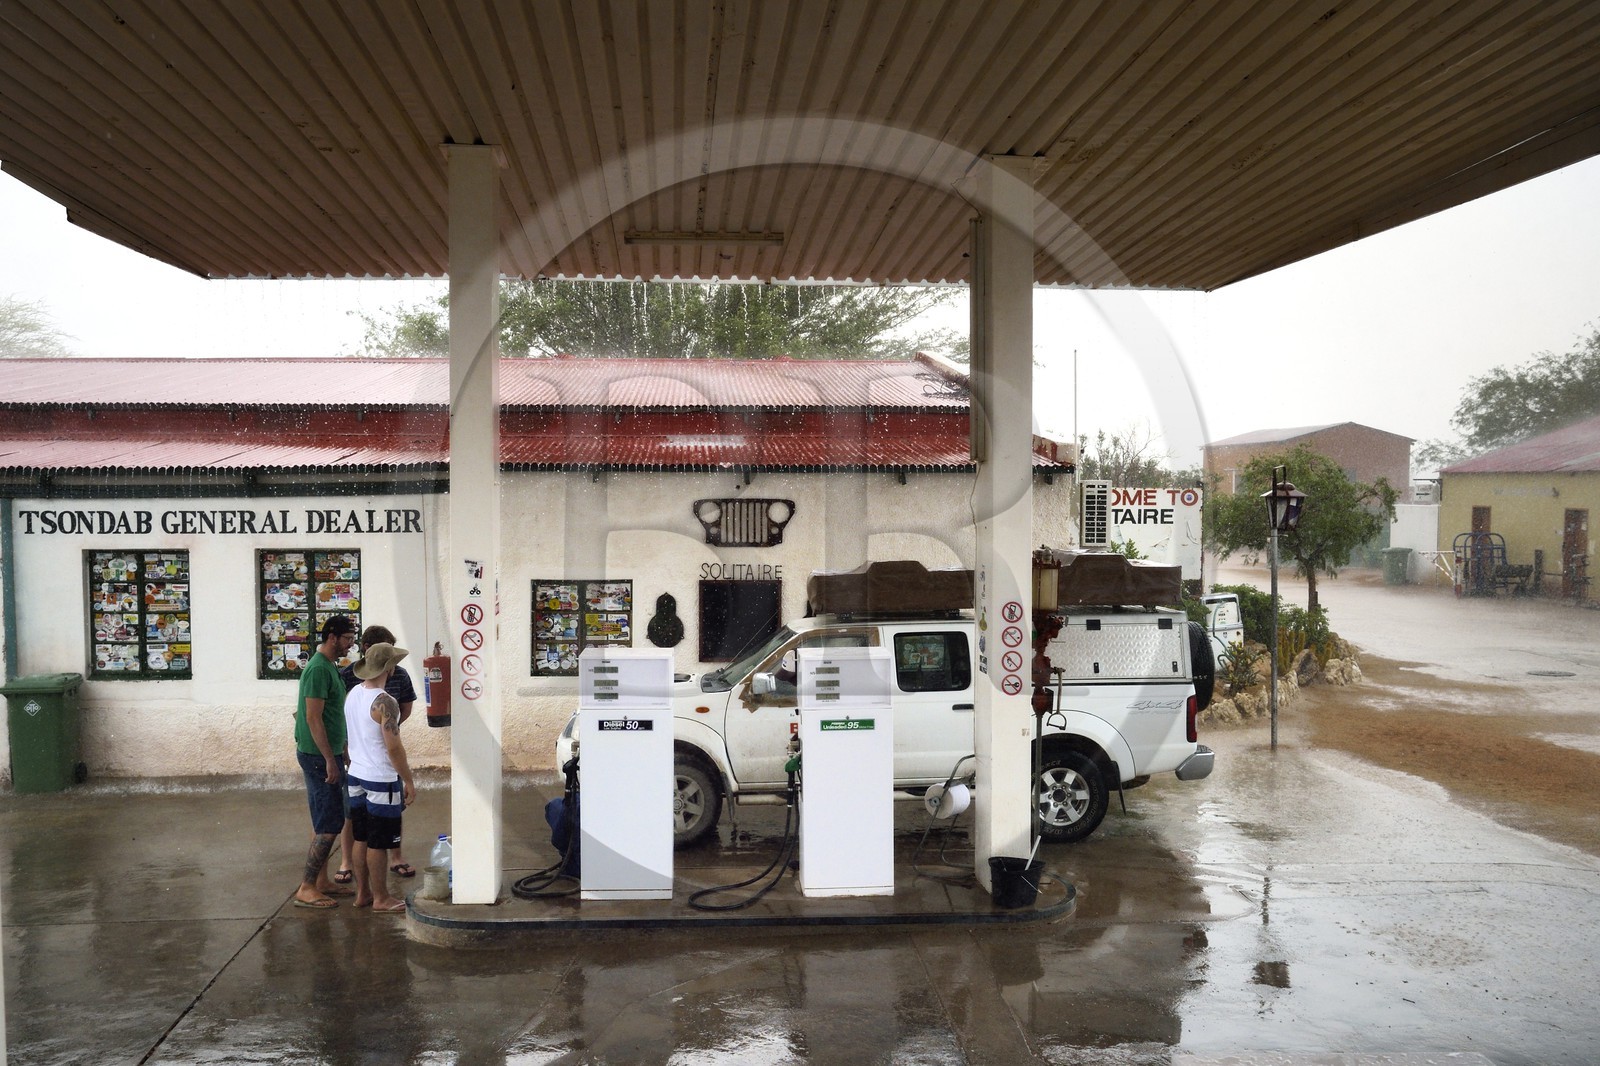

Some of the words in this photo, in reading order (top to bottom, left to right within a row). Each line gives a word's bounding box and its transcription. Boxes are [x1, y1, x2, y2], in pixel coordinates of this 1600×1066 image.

[1166, 489, 1199, 506] TO
[19, 511, 152, 535] TSONDAB
[162, 510, 296, 534] GENERAL
[306, 509, 424, 534] DEALER
[1111, 508, 1174, 525] TAIRE
[699, 562, 783, 581] SOLITAIRE
[625, 720, 639, 730] 50
[847, 721, 859, 729] 95
